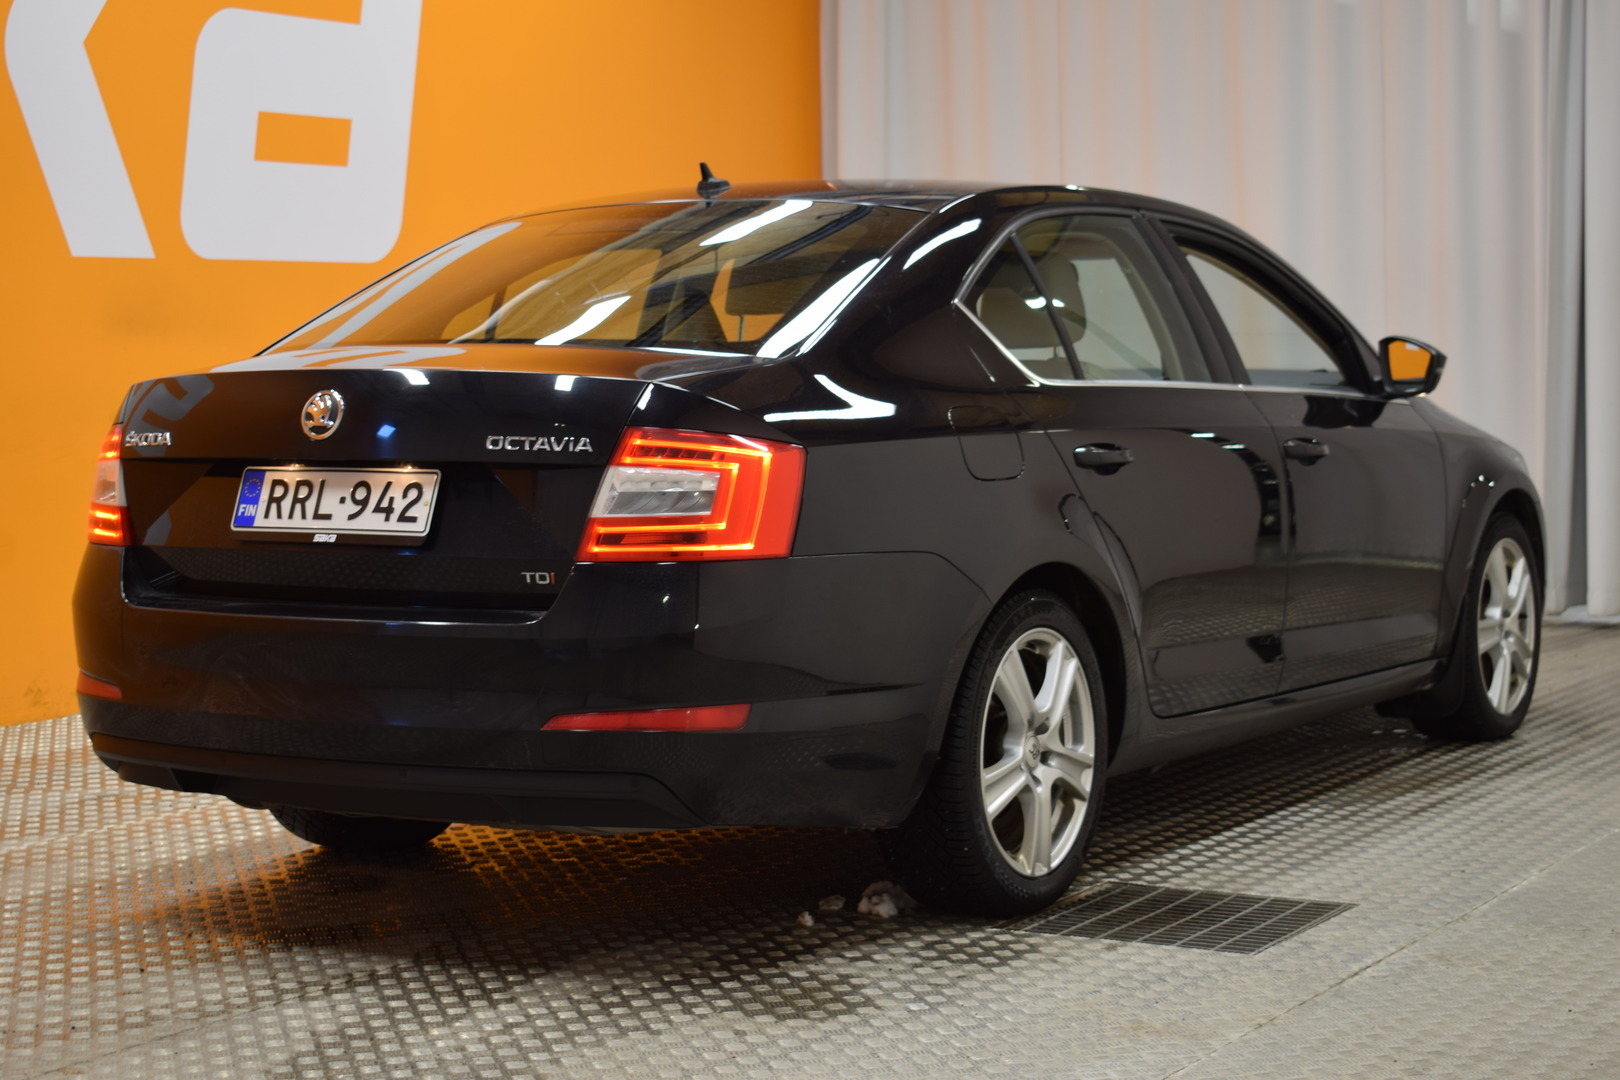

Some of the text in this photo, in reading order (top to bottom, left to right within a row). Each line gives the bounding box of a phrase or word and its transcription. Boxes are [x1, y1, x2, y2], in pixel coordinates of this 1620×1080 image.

[263, 478, 424, 524] RRL-942
[238, 504, 258, 517] FIN
[520, 571, 555, 584] TDI
